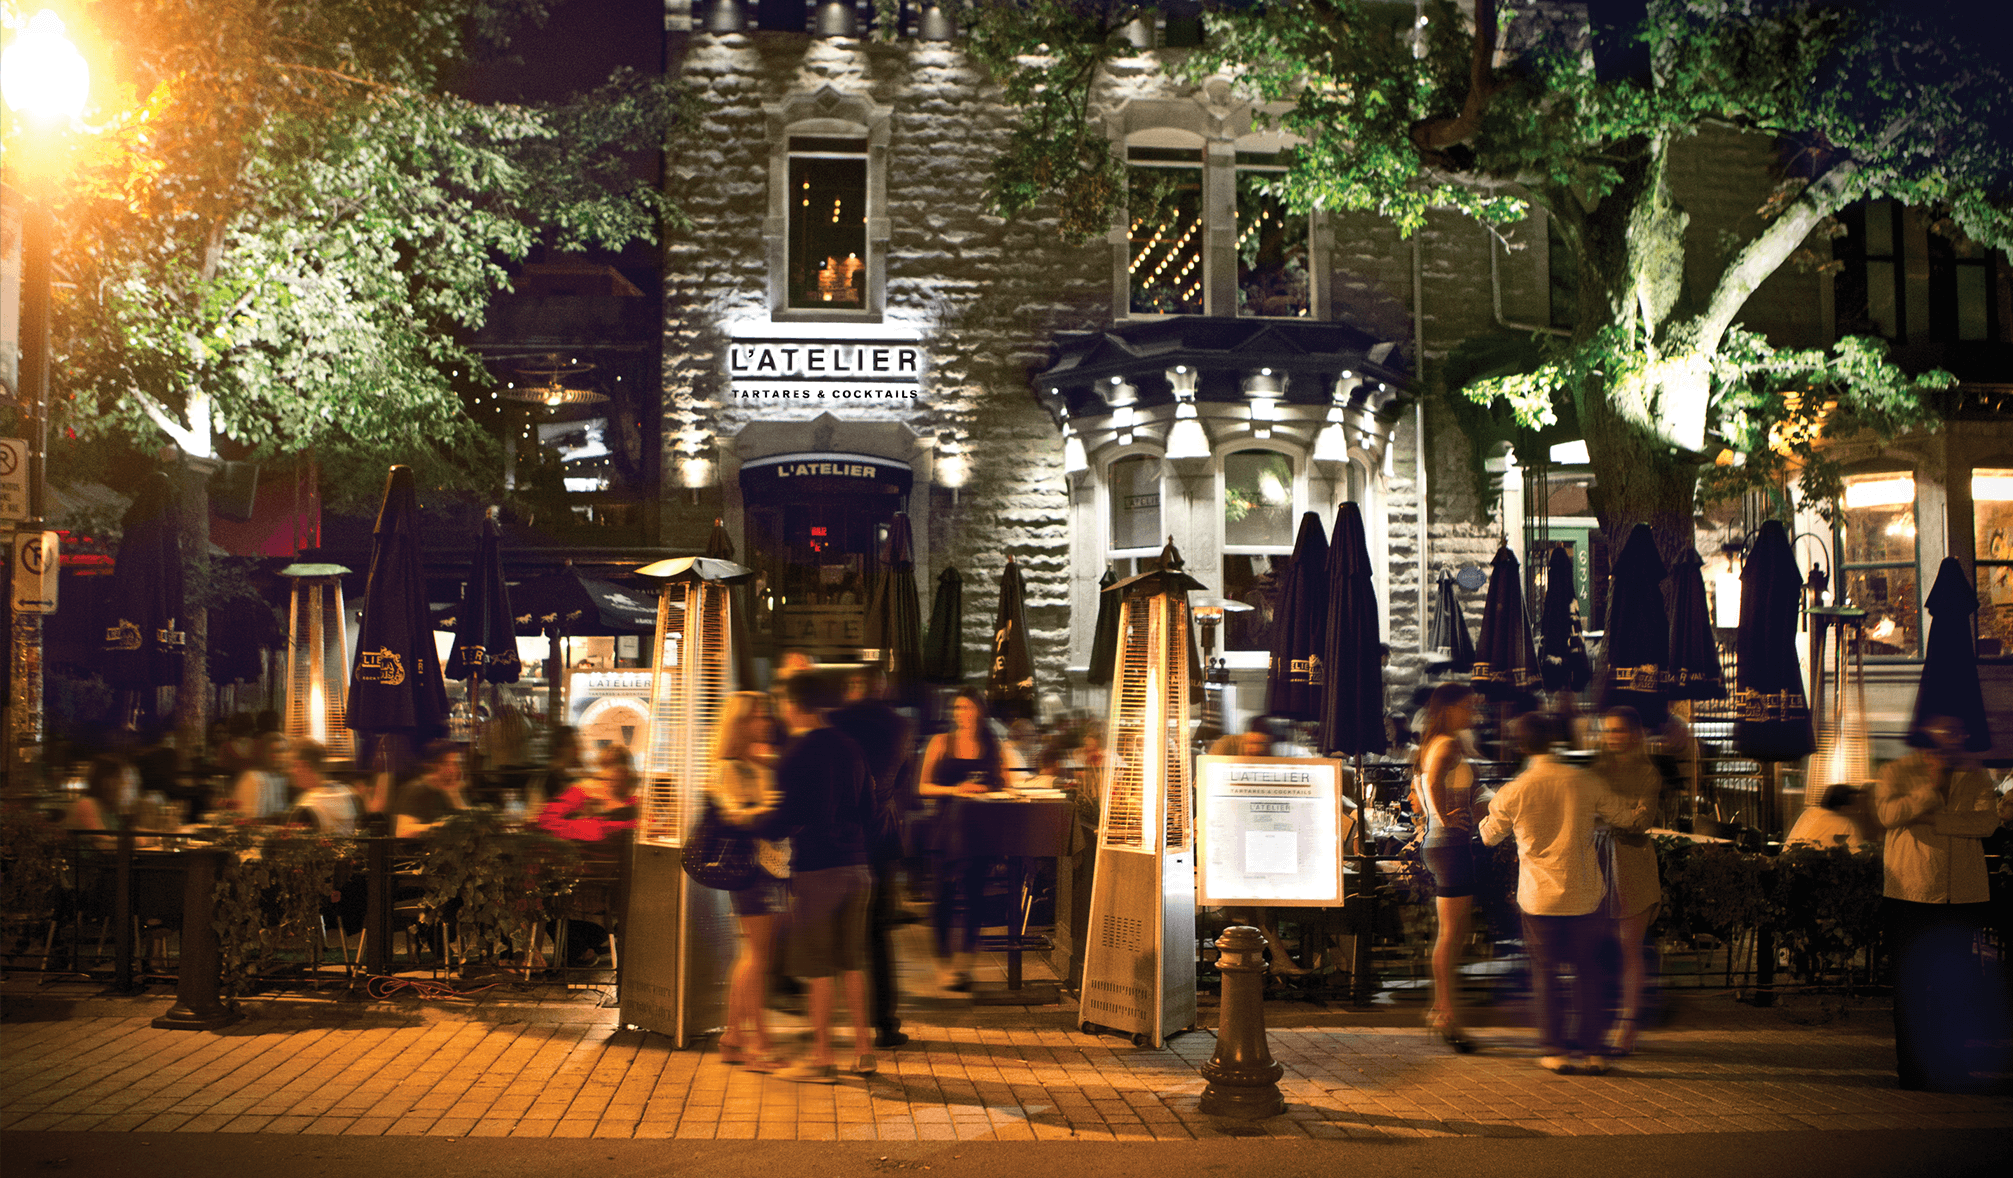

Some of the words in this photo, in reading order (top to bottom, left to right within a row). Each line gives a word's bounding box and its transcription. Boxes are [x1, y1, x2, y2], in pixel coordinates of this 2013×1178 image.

[731, 349, 917, 371] L'ATELIER
[732, 390, 811, 399] TARTARES
[817, 390, 826, 399] &
[832, 390, 918, 399] COCKTAILS
[778, 463, 876, 478] L'ATELIER
[1579, 551, 1588, 600] 634
